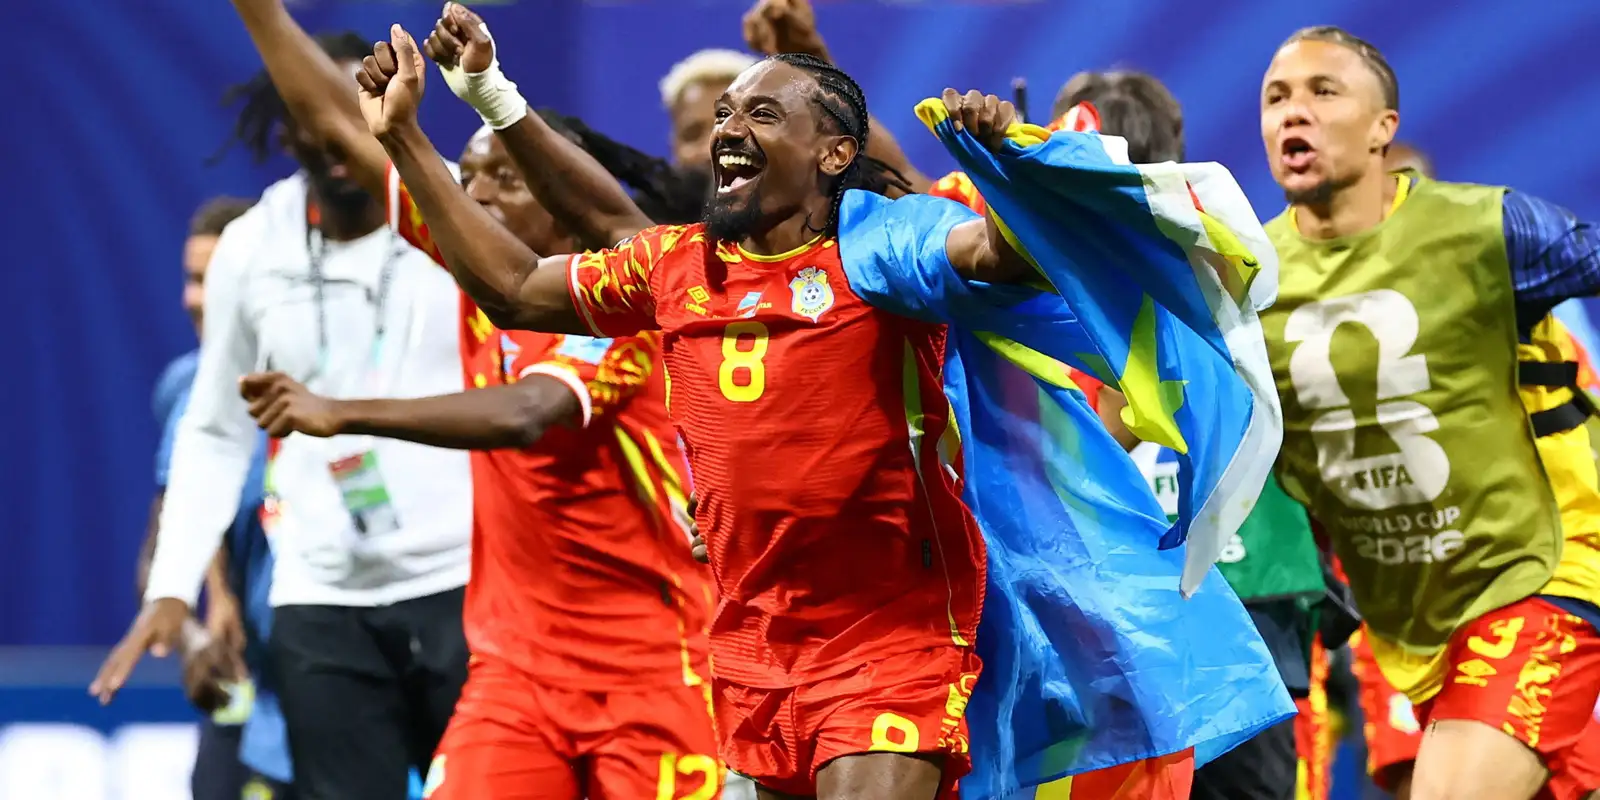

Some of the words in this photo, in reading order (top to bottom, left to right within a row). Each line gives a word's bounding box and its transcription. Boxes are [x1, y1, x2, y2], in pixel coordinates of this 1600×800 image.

[719, 321, 769, 402] 8
[1354, 464, 1414, 489] FIFA
[1339, 514, 1412, 533] WORLD
[1416, 506, 1460, 529] CUP
[1354, 531, 1465, 565] 2026
